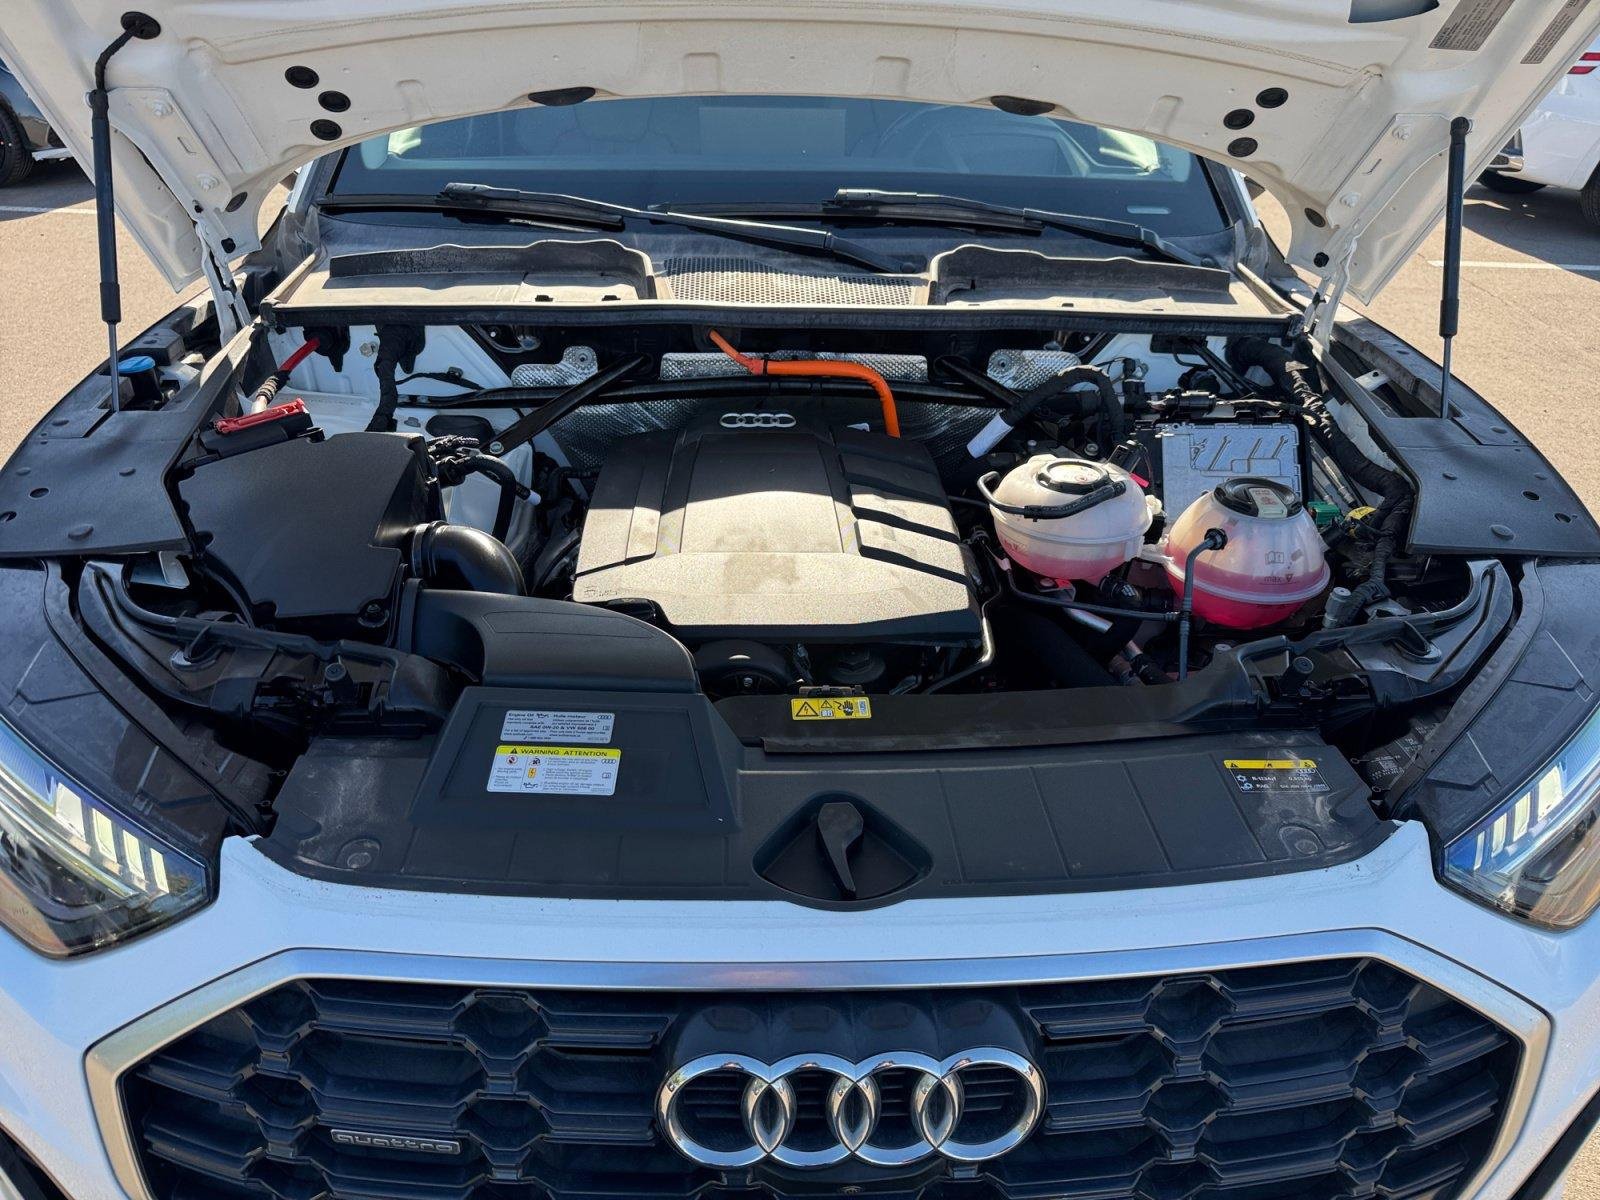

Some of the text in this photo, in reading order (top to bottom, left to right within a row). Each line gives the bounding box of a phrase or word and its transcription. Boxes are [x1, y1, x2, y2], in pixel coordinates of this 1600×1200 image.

[521, 748, 608, 757] WARNING ATTENTION
[336, 1134, 453, 1151] quattro
